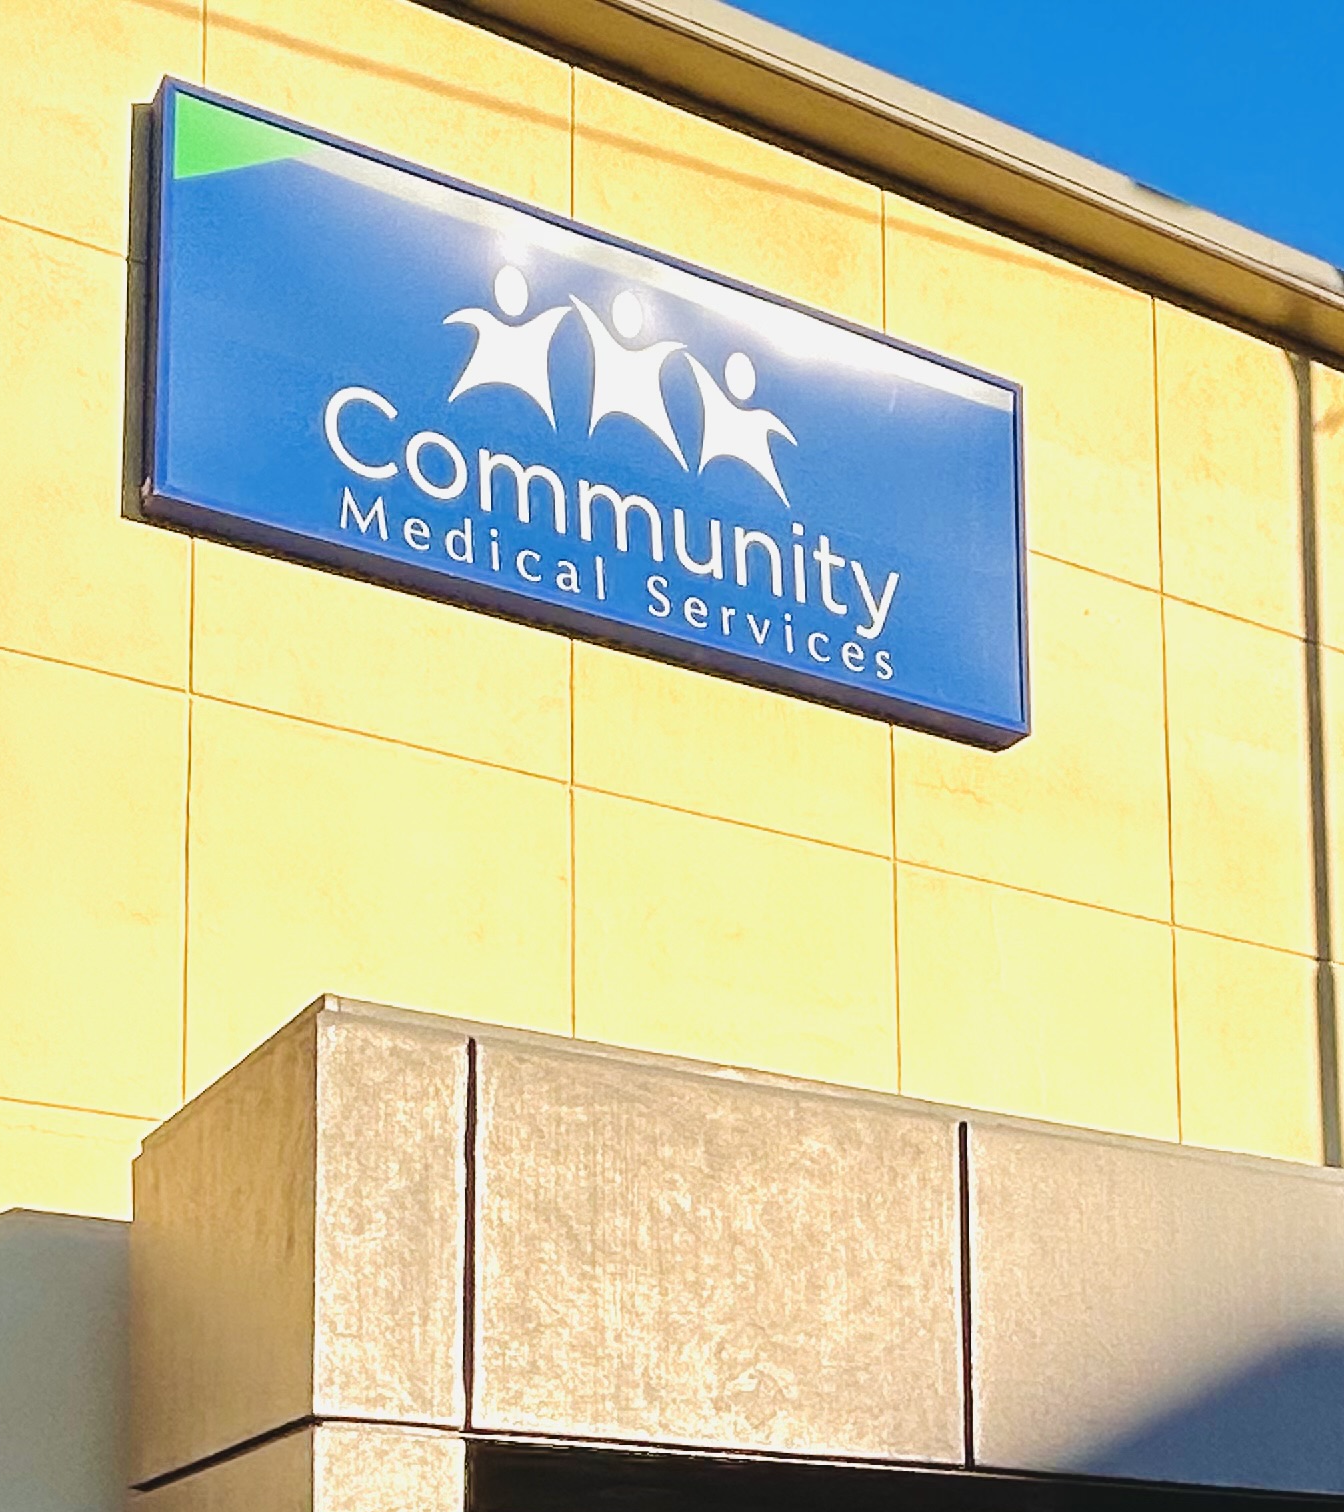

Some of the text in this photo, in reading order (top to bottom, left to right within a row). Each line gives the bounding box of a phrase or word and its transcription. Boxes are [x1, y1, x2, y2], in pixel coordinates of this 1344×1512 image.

[323, 385, 900, 640] Community
[339, 485, 896, 681] Medical Services
